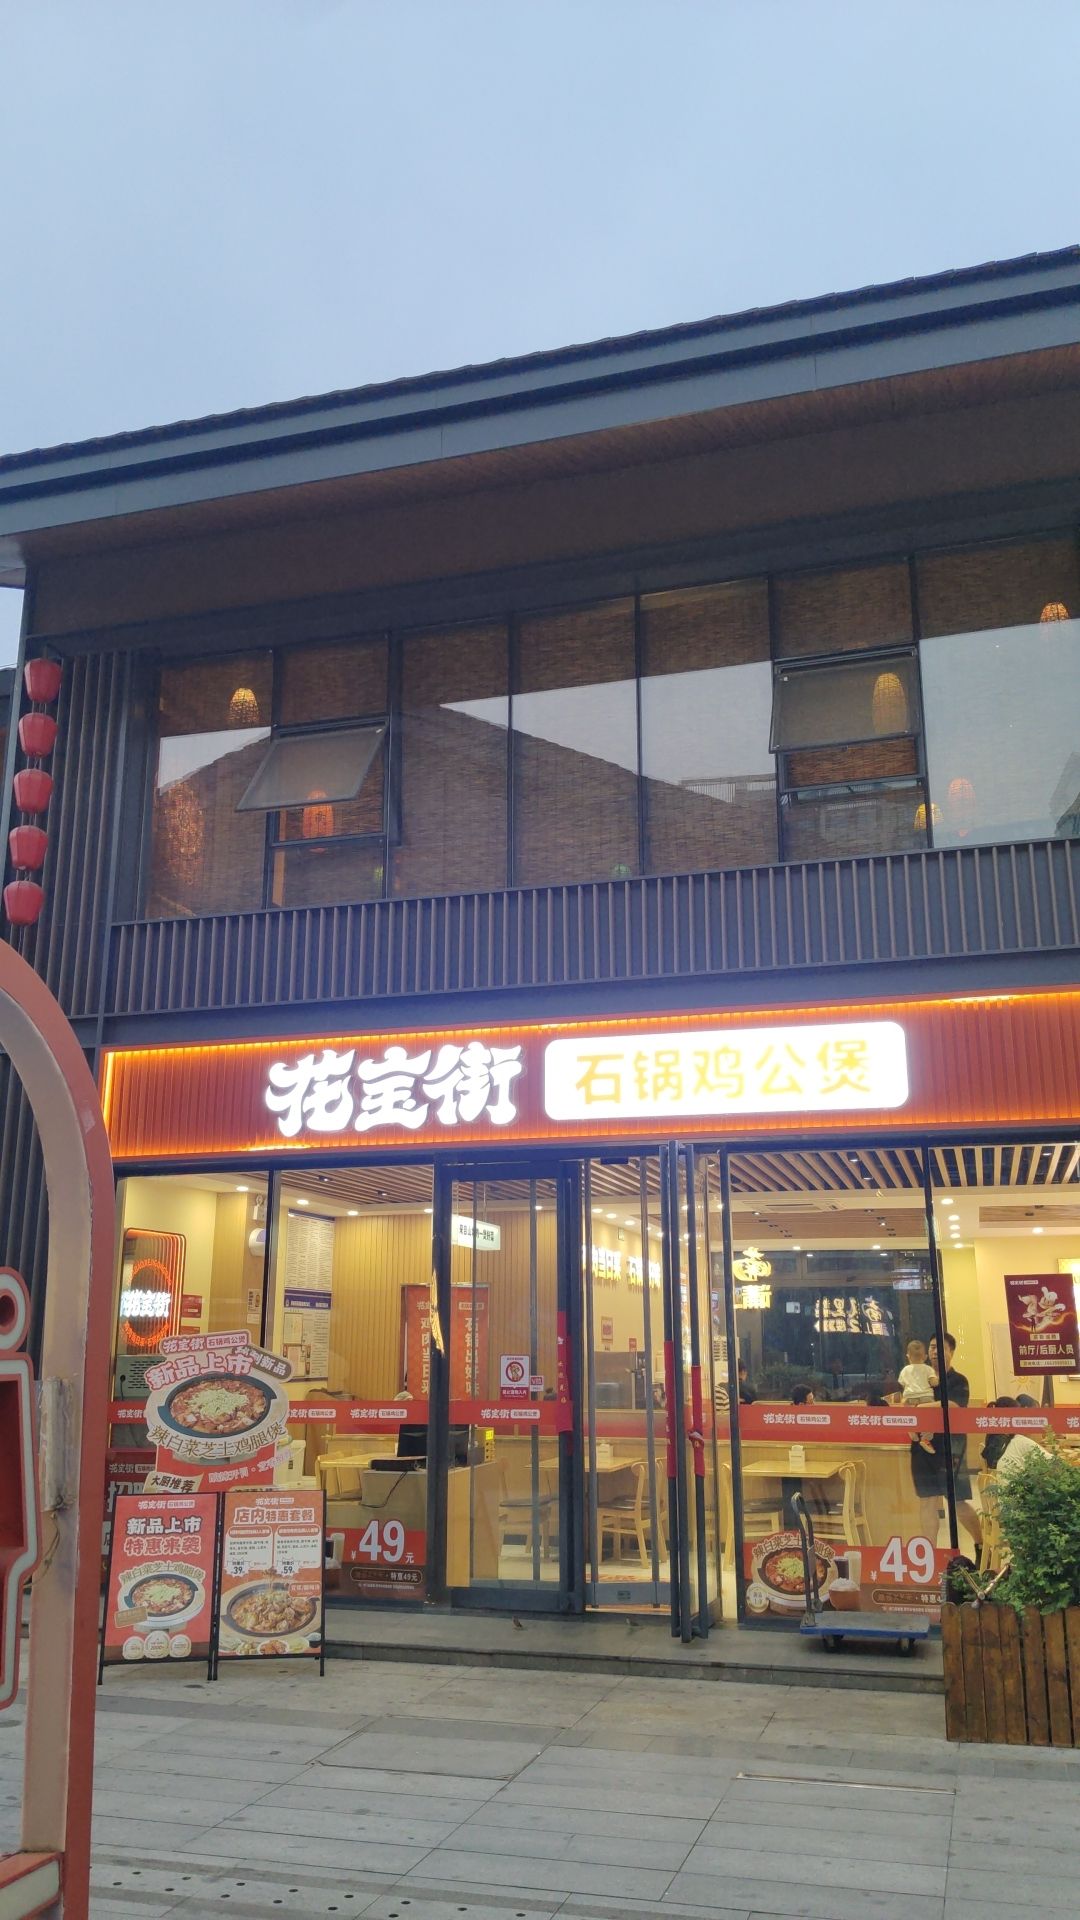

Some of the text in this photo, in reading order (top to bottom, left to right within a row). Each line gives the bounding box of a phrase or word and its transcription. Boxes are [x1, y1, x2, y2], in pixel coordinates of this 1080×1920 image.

[576, 1040, 871, 1104] 石锅鸡公煲
[147, 1353, 252, 1389] 新品上市
[151, 1421, 286, 1458] 辣白菜芝士鸡腿煲
[151, 1475, 196, 1493] 大厨推荐
[126, 1517, 202, 1534] 新品上市
[234, 1508, 315, 1524] 店内特惠套餐
[124, 1536, 202, 1556] 特惠来袭
[359, 1520, 405, 1562] 49
[880, 1537, 935, 1583] 49
